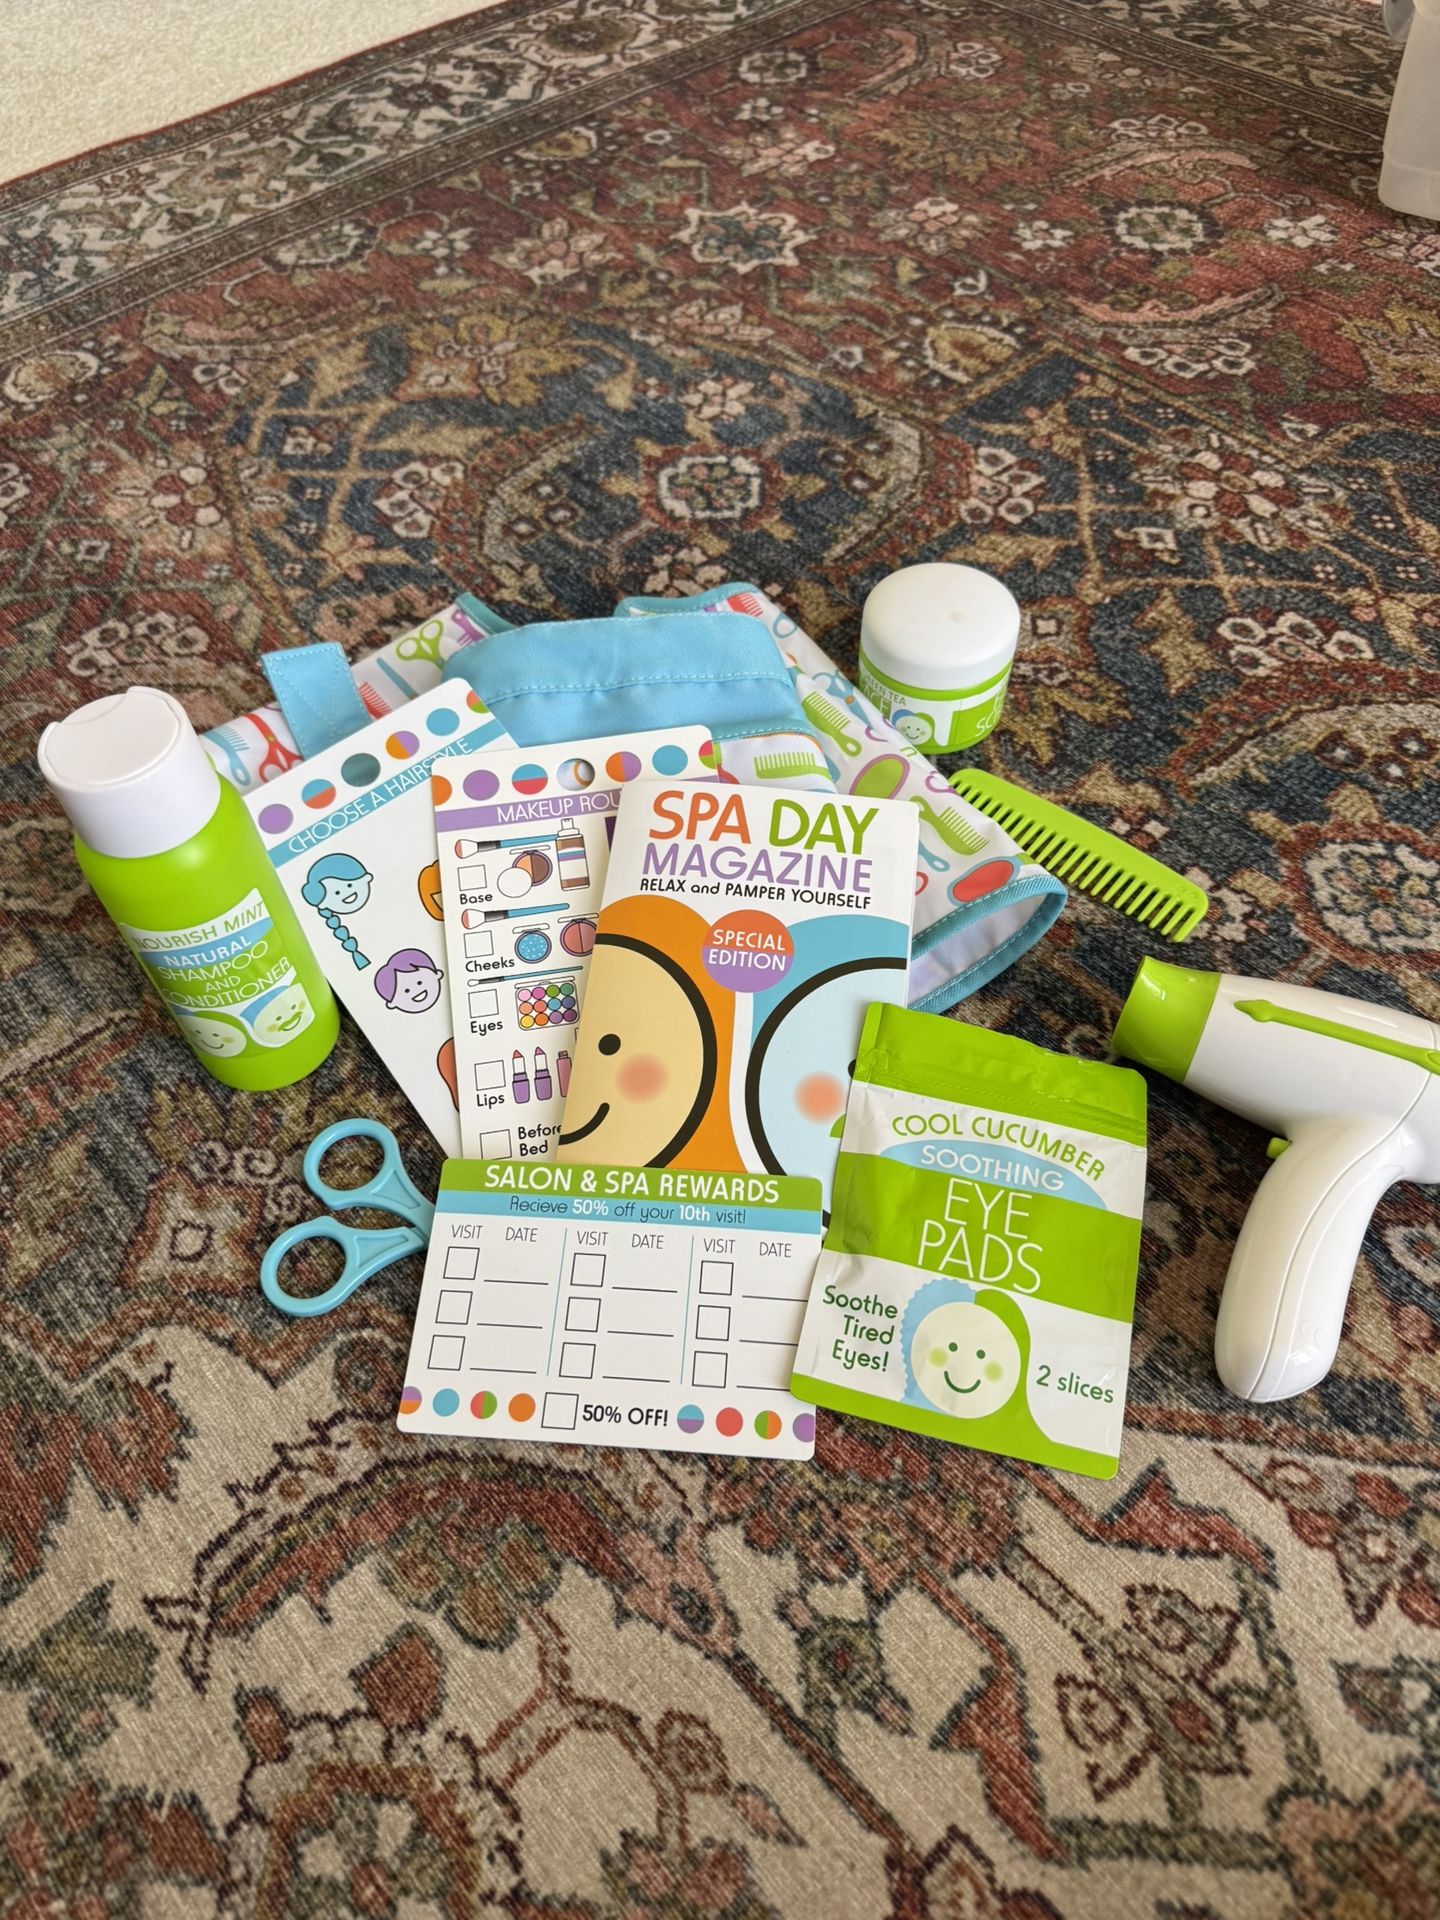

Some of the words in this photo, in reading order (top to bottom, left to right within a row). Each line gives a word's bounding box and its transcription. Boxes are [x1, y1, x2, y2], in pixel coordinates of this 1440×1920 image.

[889, 691, 906, 706] TEA
[289, 801, 369, 853] CHOOSE
[371, 791, 387, 808] A
[497, 798, 574, 823] MAKEUP
[649, 790, 752, 844] SPA
[769, 798, 879, 855] DAY
[642, 842, 873, 893] MAGAZINE
[460, 893, 493, 905] Base
[640, 878, 686, 893] RELAX
[690, 881, 721, 895] and
[725, 883, 786, 901] PAMPER
[791, 888, 871, 910] YOURSELF
[132, 925, 218, 950] NOURISH
[224, 901, 265, 933] MINT
[712, 929, 786, 951] SPECIAL
[158, 940, 268, 982] SHAMPOO
[163, 935, 252, 968] NATURAL
[465, 957, 515, 973] Cheeks
[708, 949, 786, 972] EDITION
[206, 975, 241, 992] AND
[470, 1019, 503, 1036] Eyes
[476, 1093, 505, 1109] Lips
[520, 1140, 548, 1157] Bed
[892, 1113, 963, 1137] COOL
[971, 1116, 1106, 1182] CUCUMBER
[484, 1164, 571, 1192] SALON
[580, 1169, 598, 1193] &
[605, 1171, 649, 1196] SPA
[659, 1173, 779, 1203] REWARDS
[920, 1145, 1065, 1192] SOOTHING
[510, 1195, 568, 1214] Recieve
[572, 1199, 609, 1216] 50%
[614, 1202, 636, 1218] off
[640, 1205, 675, 1223] your
[679, 1204, 711, 1222] 10th
[715, 1208, 746, 1225] visit!
[944, 1177, 1032, 1240] EYE
[451, 1224, 484, 1240] VISIT
[505, 1227, 538, 1243] DATE
[576, 1230, 609, 1247] VISIT
[631, 1233, 664, 1250] DATE
[703, 1237, 736, 1254] VISIT
[759, 1241, 792, 1258] DATE
[917, 1218, 1043, 1295] PADS
[822, 1284, 898, 1320] Soothe
[842, 1314, 895, 1345] Tired
[832, 1340, 889, 1372] Eyes!
[1035, 1365, 1051, 1387] 2
[1057, 1371, 1114, 1404] slices
[582, 1404, 622, 1424] 50%
[628, 1405, 668, 1428] OFF!
